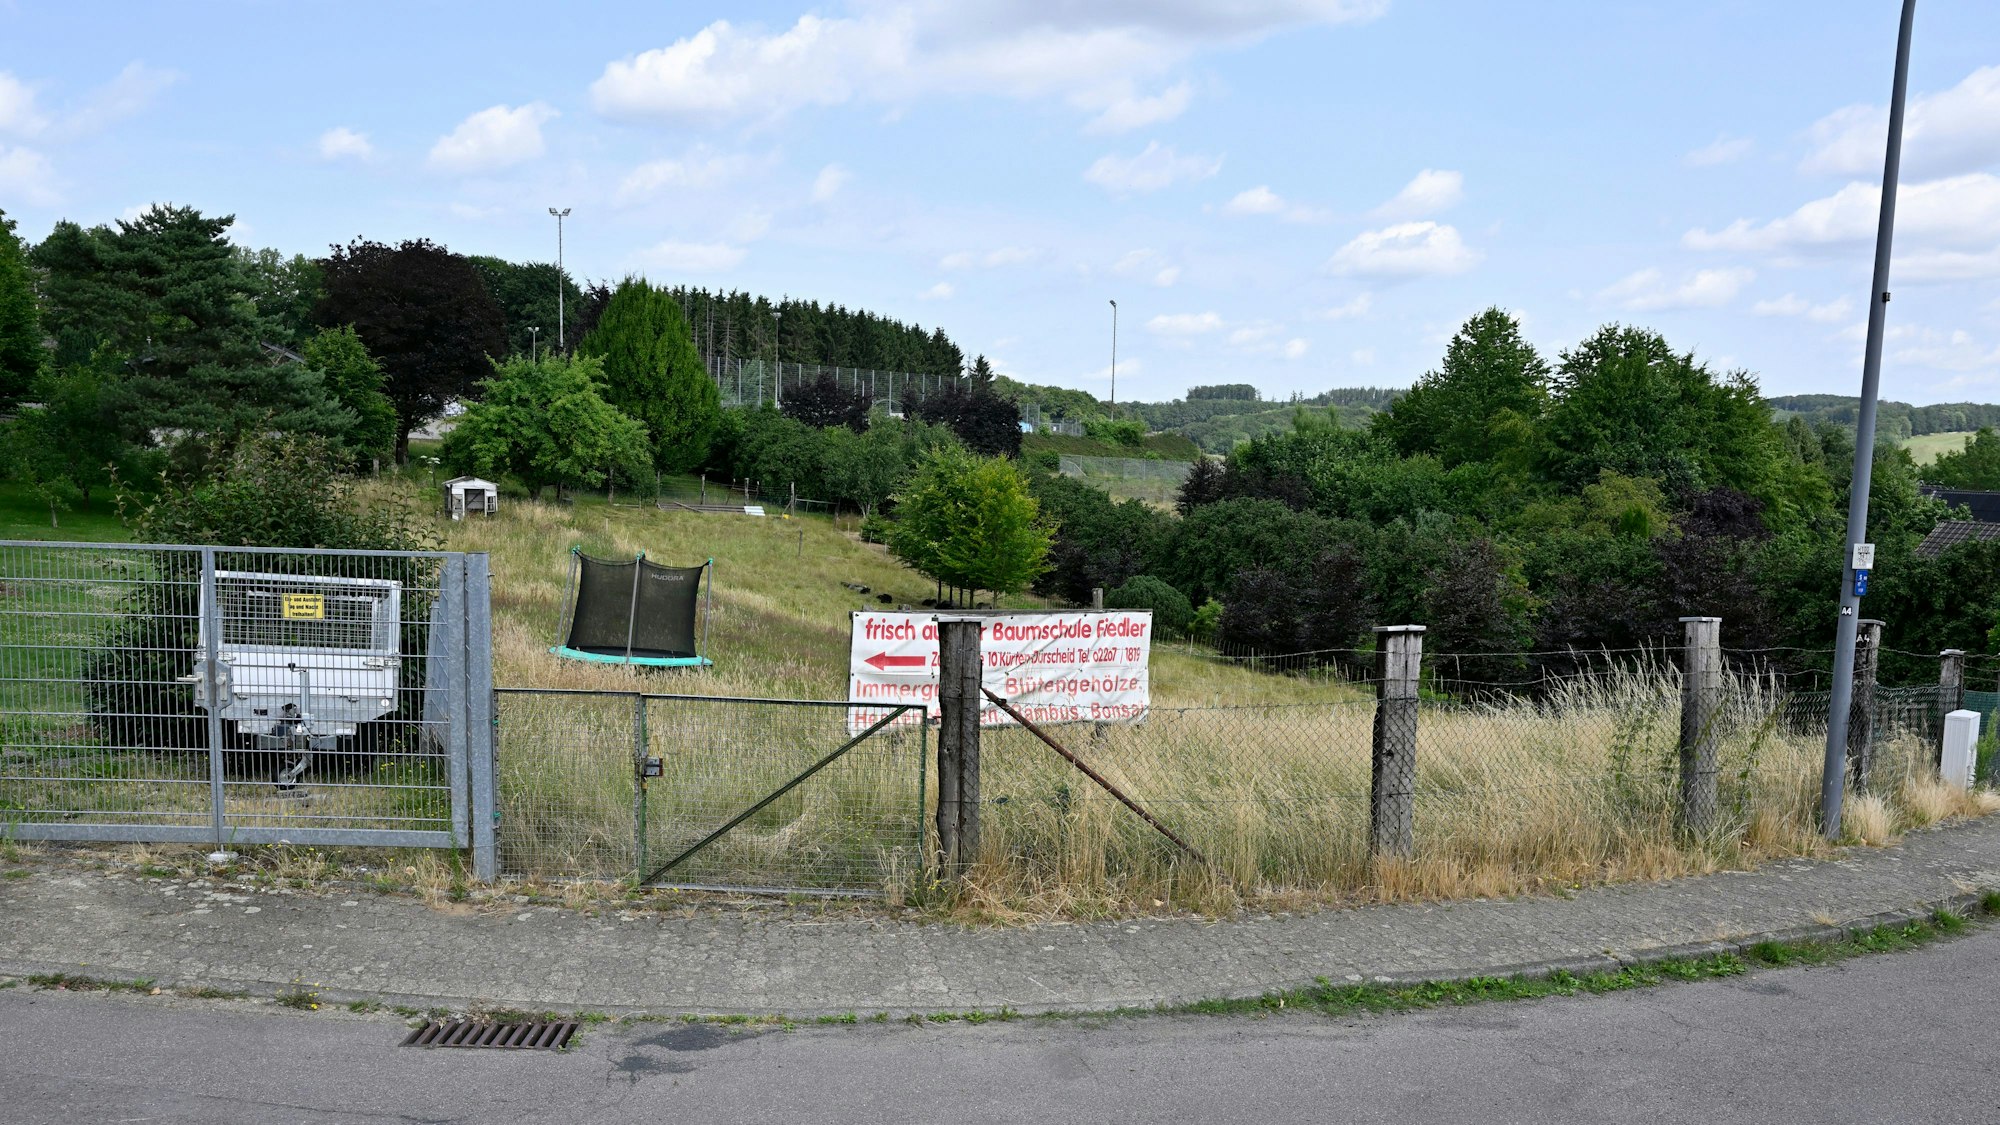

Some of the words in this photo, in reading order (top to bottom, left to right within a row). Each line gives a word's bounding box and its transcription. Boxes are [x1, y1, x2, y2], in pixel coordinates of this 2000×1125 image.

[651, 573, 684, 581] HUDORA
[1842, 607, 1852, 615] A4
[865, 618, 916, 640] frisch
[922, 624, 940, 640] au
[993, 618, 1092, 641] Baumschule
[1097, 617, 1147, 638] Fiedler
[1856, 634, 1870, 642] A4
[988, 652, 998, 667] 10
[1078, 650, 1090, 663] Tel.
[1125, 647, 1141, 662] 1819
[856, 679, 940, 701] Immergr
[1090, 701, 1145, 719] Bonsai
